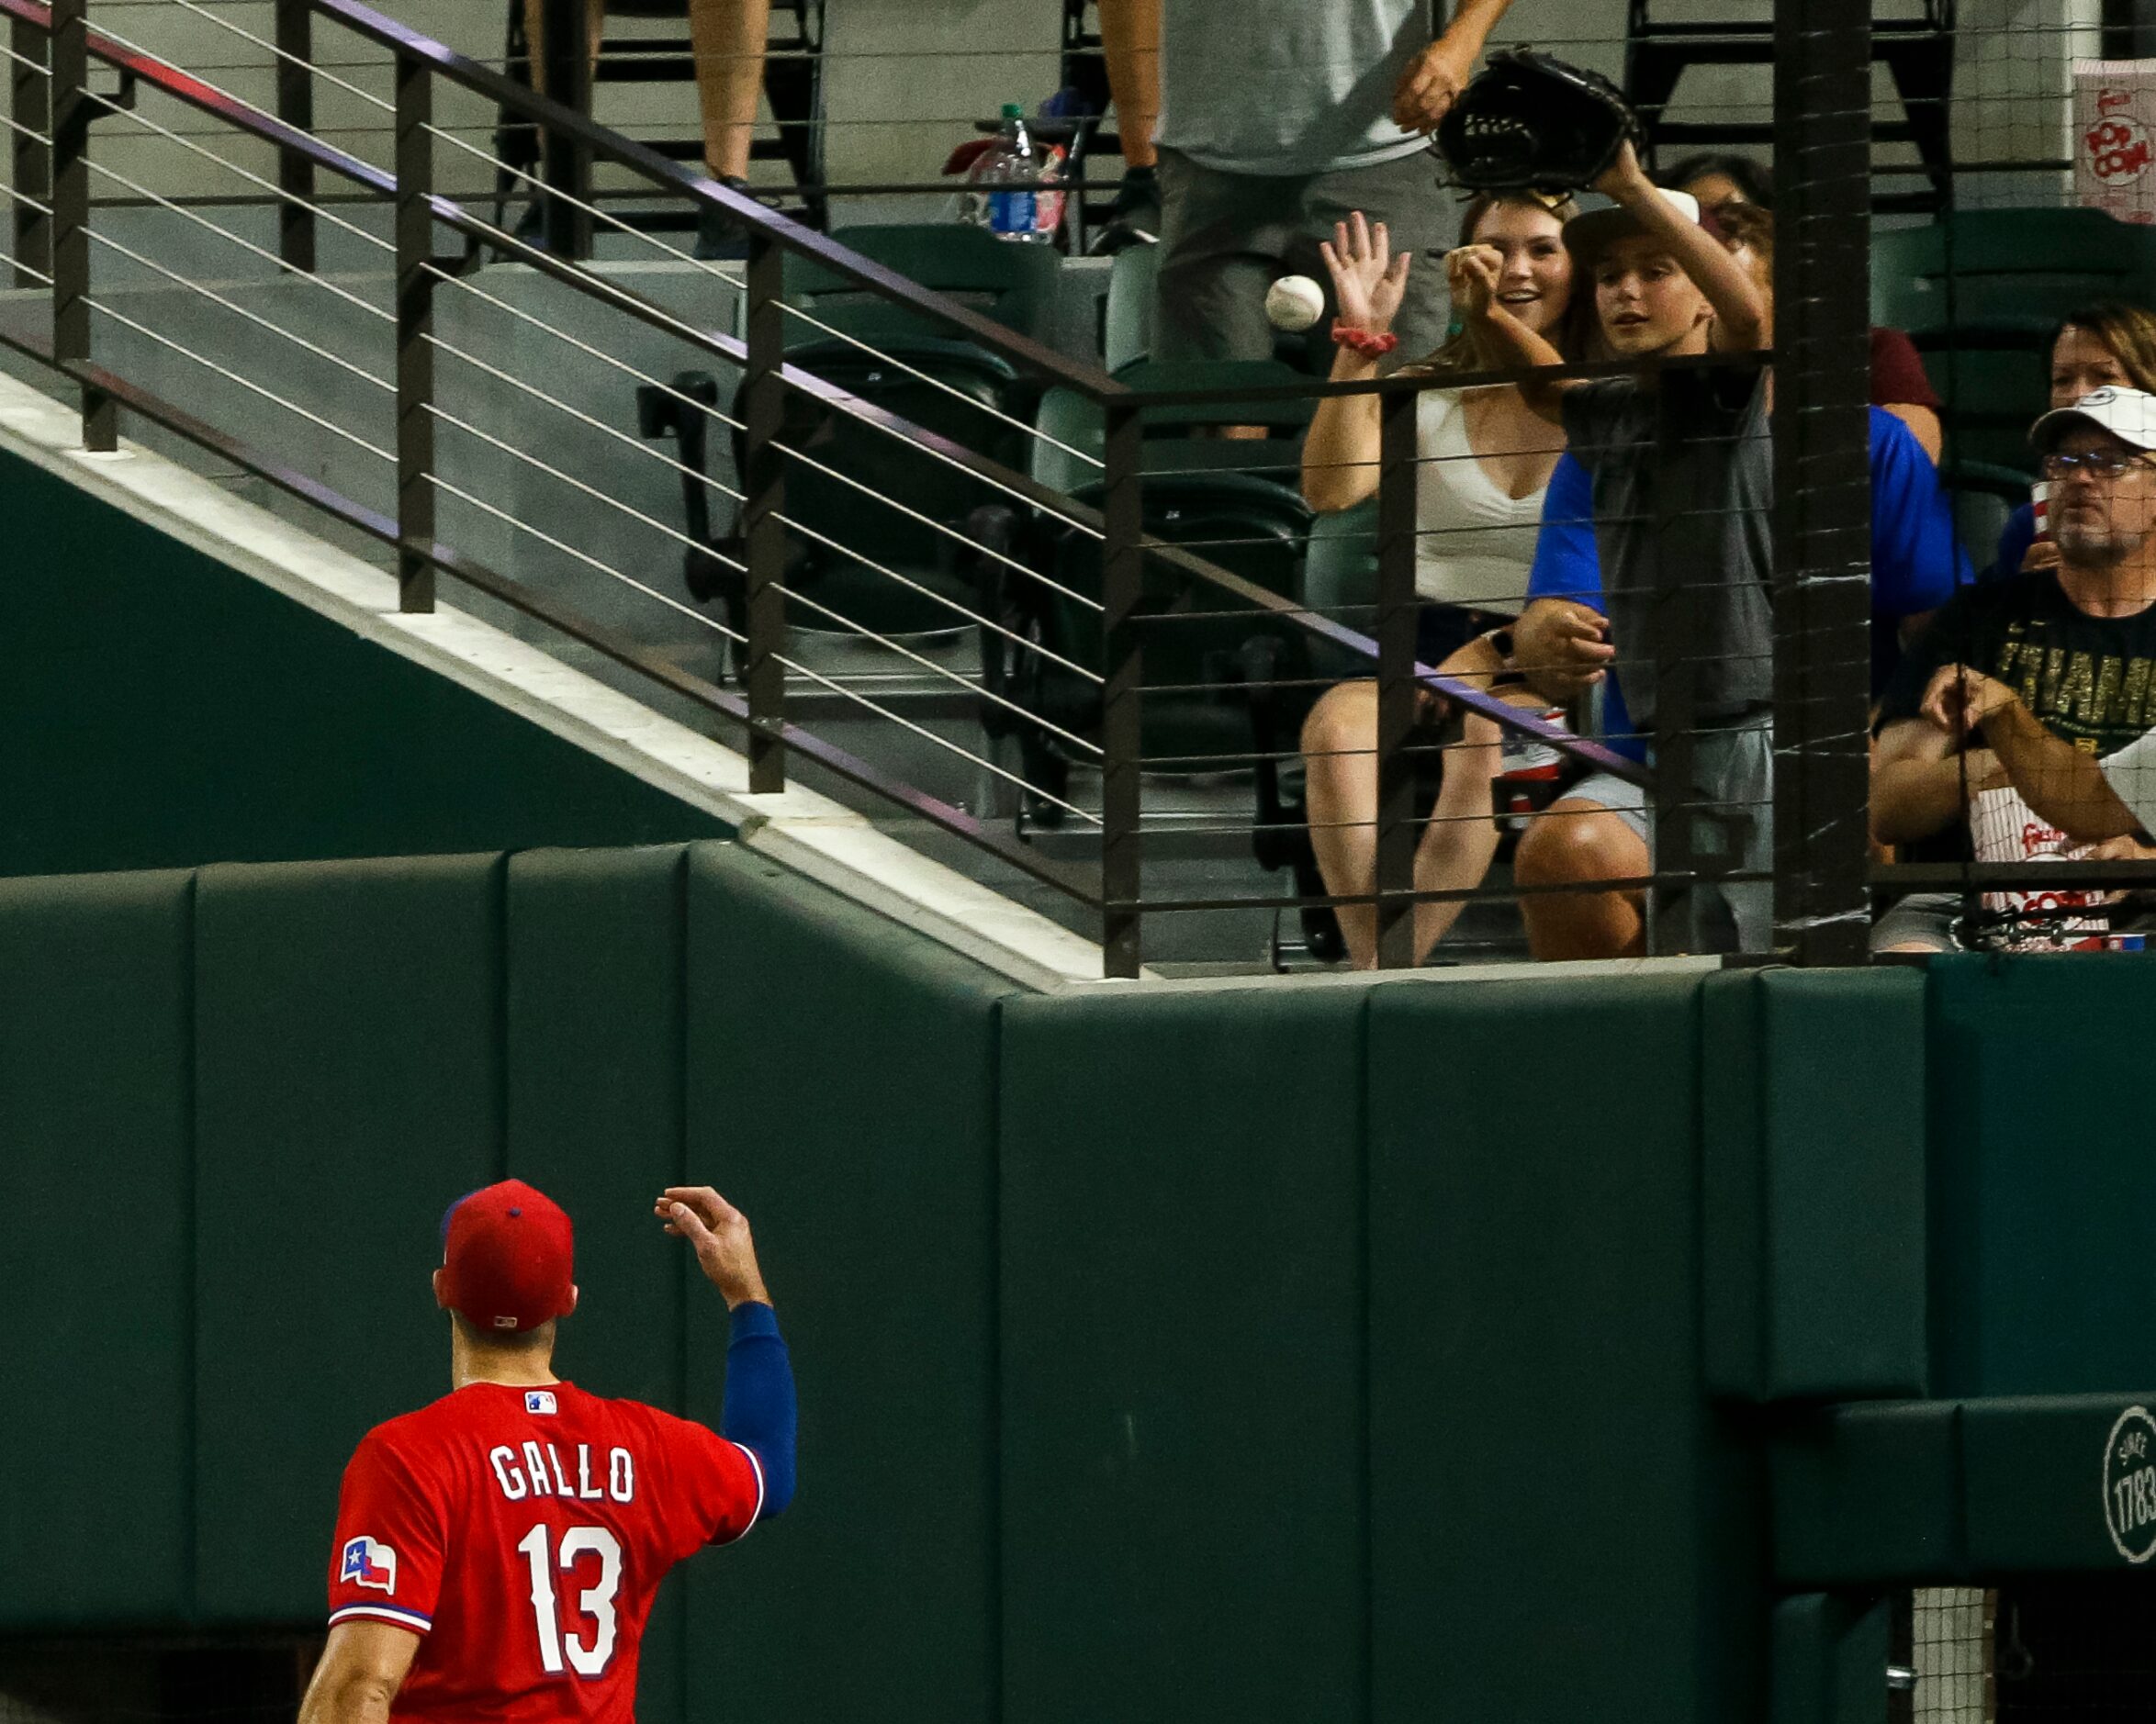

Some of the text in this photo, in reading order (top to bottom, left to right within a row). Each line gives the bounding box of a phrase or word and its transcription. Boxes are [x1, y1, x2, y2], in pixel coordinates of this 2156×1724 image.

[489, 1440, 634, 1503] GALLO
[2114, 1465, 2156, 1533] 1783
[517, 1523, 623, 1675] 13
